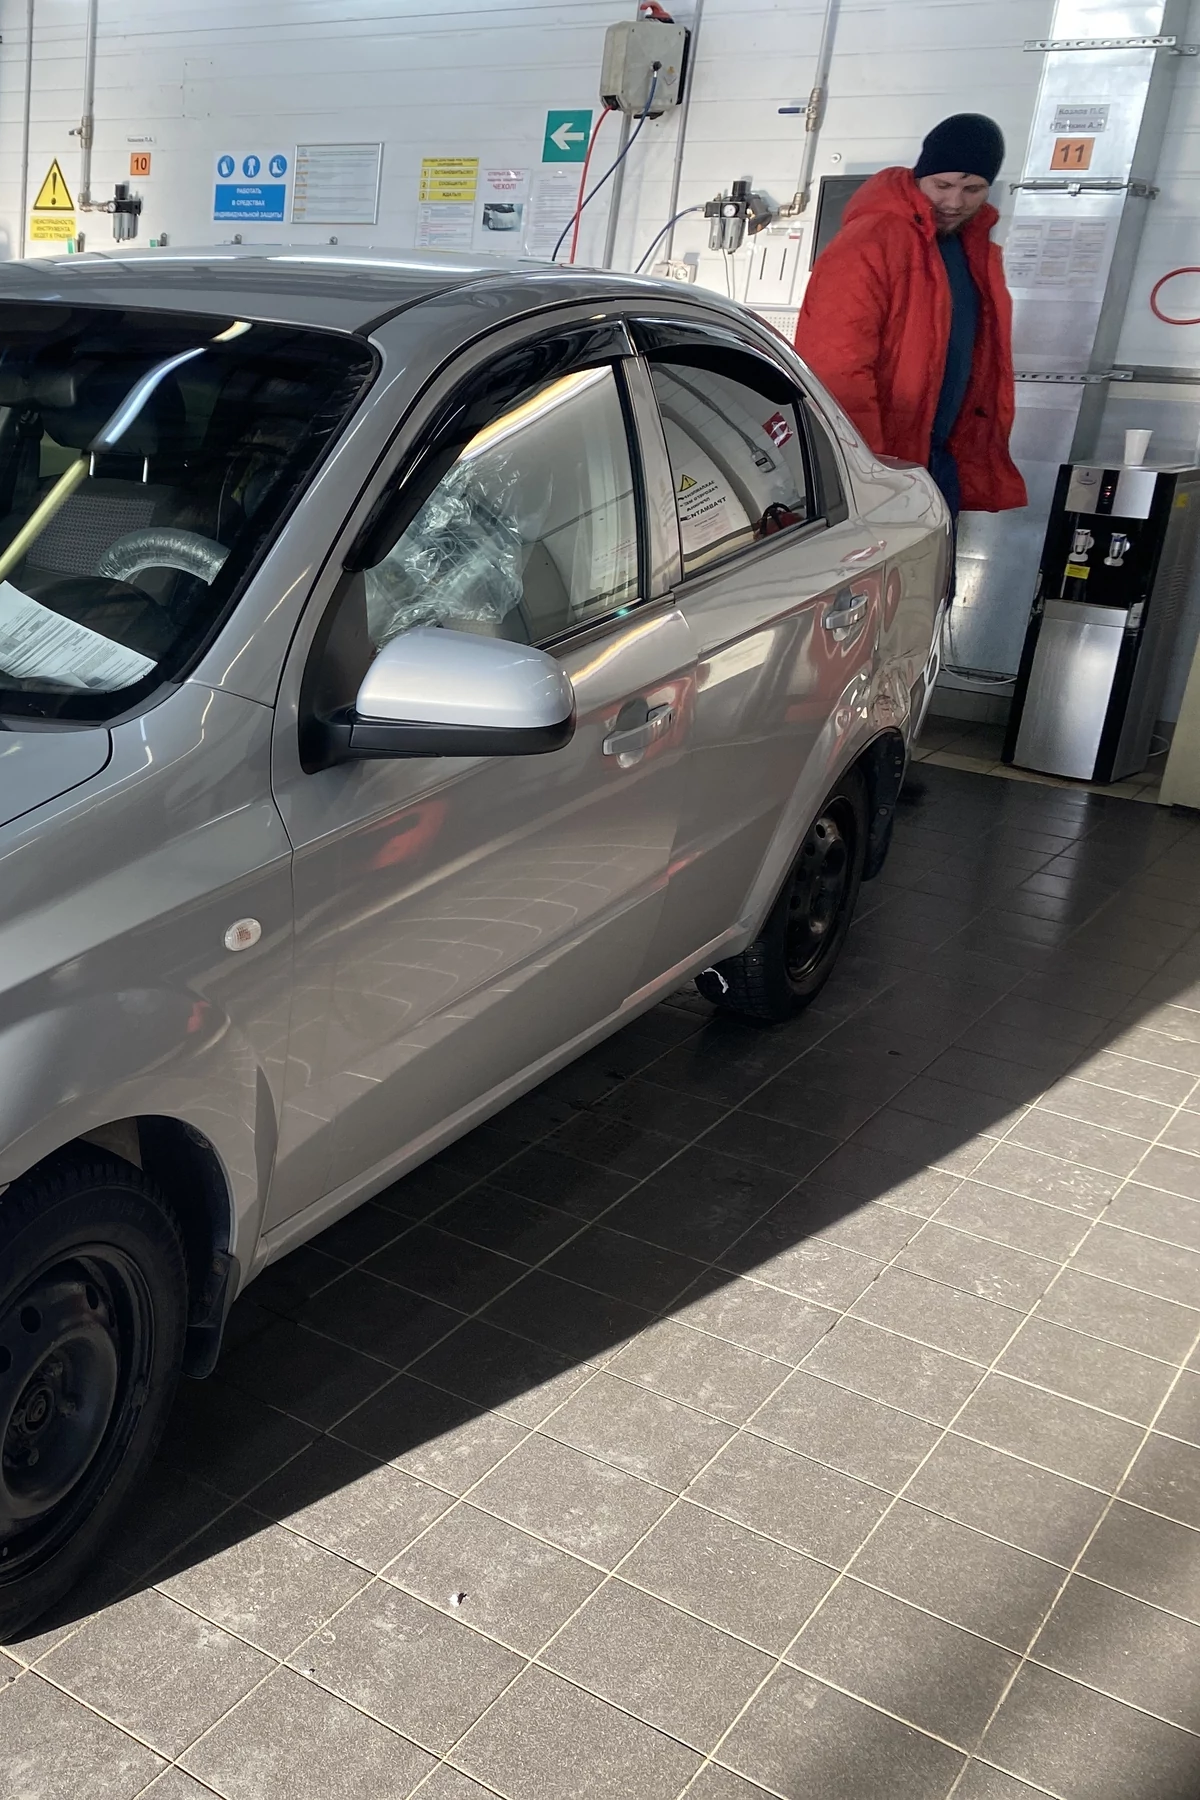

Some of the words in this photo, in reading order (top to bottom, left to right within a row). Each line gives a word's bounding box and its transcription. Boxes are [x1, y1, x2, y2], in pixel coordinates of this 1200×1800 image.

[1060, 143, 1085, 163] 11
[133, 156, 148, 171] 10
[236, 187, 262, 195] РАБОТАТЬ
[236, 199, 266, 207] СРЕДСТВАХ
